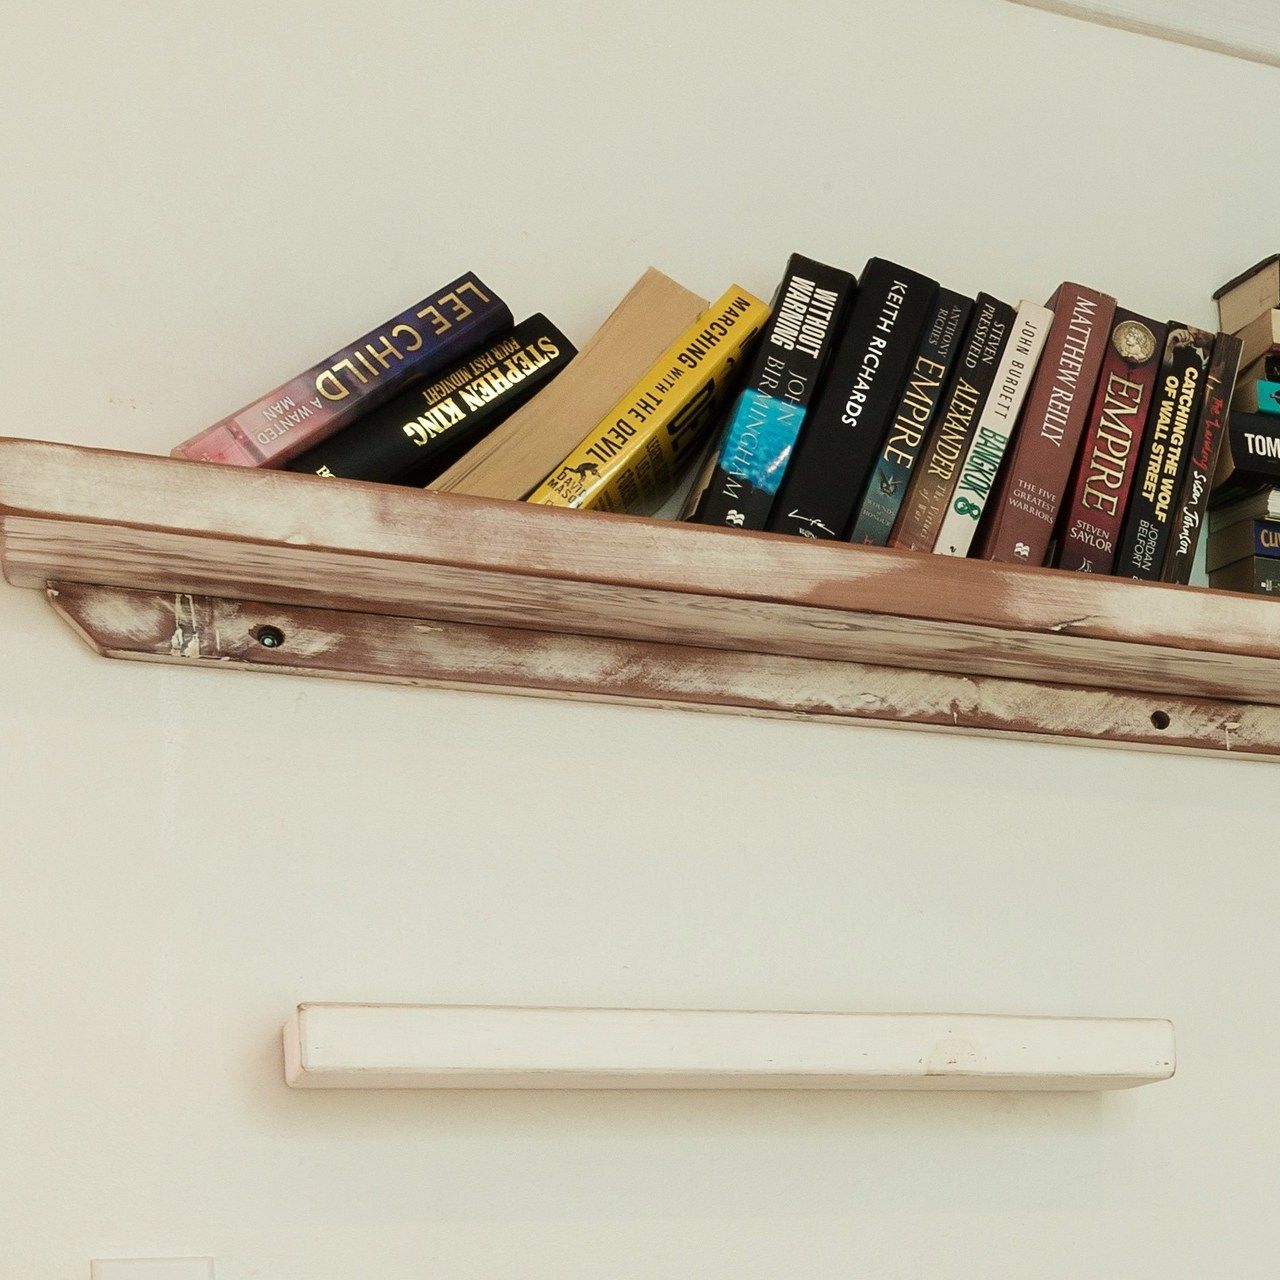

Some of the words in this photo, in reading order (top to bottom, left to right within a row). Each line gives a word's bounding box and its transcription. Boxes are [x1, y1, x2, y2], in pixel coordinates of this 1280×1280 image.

[416, 280, 491, 336] LEE
[676, 295, 752, 369] MARCHING
[769, 274, 816, 352] WARNING
[794, 287, 839, 361] WITHOUT
[875, 279, 909, 334] KEITH
[928, 307, 949, 348] RICHES
[500, 335, 522, 358] FOUR
[941, 305, 963, 360] ANTHONY
[963, 302, 997, 370] PRESSFIELD
[981, 321, 1006, 367] STEVEN
[1015, 320, 1038, 356] JOHN
[1056, 294, 1099, 387] MATTHEW
[314, 323, 425, 402] CHILD
[421, 362, 478, 406] MIDNIGHT
[457, 335, 561, 415] STEPHEN
[473, 349, 503, 371] PAST
[654, 366, 686, 395] WITH
[840, 334, 889, 429] RICHARDS
[262, 395, 294, 422] MAN
[312, 396, 324, 410] A
[626, 390, 664, 424] THE
[776, 368, 809, 427] JOHN
[883, 355, 946, 470] EMPIRE
[993, 359, 1026, 421] BURDETT
[1162, 375, 1180, 400] OF
[1168, 365, 1200, 450] CATCHING
[257, 401, 315, 446] WANTED
[401, 398, 469, 449] KING
[585, 419, 638, 464] DEVIL
[722, 354, 786, 500] BIRMINGHAM
[926, 376, 982, 482] ALEXANDER
[1039, 386, 1072, 448] REILLY
[1150, 400, 1175, 446] WALL
[957, 425, 1011, 502] BANGKOK
[1080, 370, 1145, 518] EMPIRE
[1162, 448, 1184, 477] THE
[1017, 478, 1037, 495] THE
[1036, 485, 1058, 503] FIVE
[1141, 443, 1165, 504] STREET
[1154, 473, 1177, 524] WOLF
[1187, 469, 1208, 507] Susan
[953, 495, 982, 522] 8
[1007, 496, 1055, 526] WARRIORS
[1012, 487, 1057, 514] GREATEST
[1069, 526, 1113, 555] SAYLOR
[1076, 518, 1111, 540] STEVEN
[1130, 518, 1151, 570] BELFORT
[1141, 523, 1161, 572] JORDAN
[1175, 502, 1201, 557] Johnson
